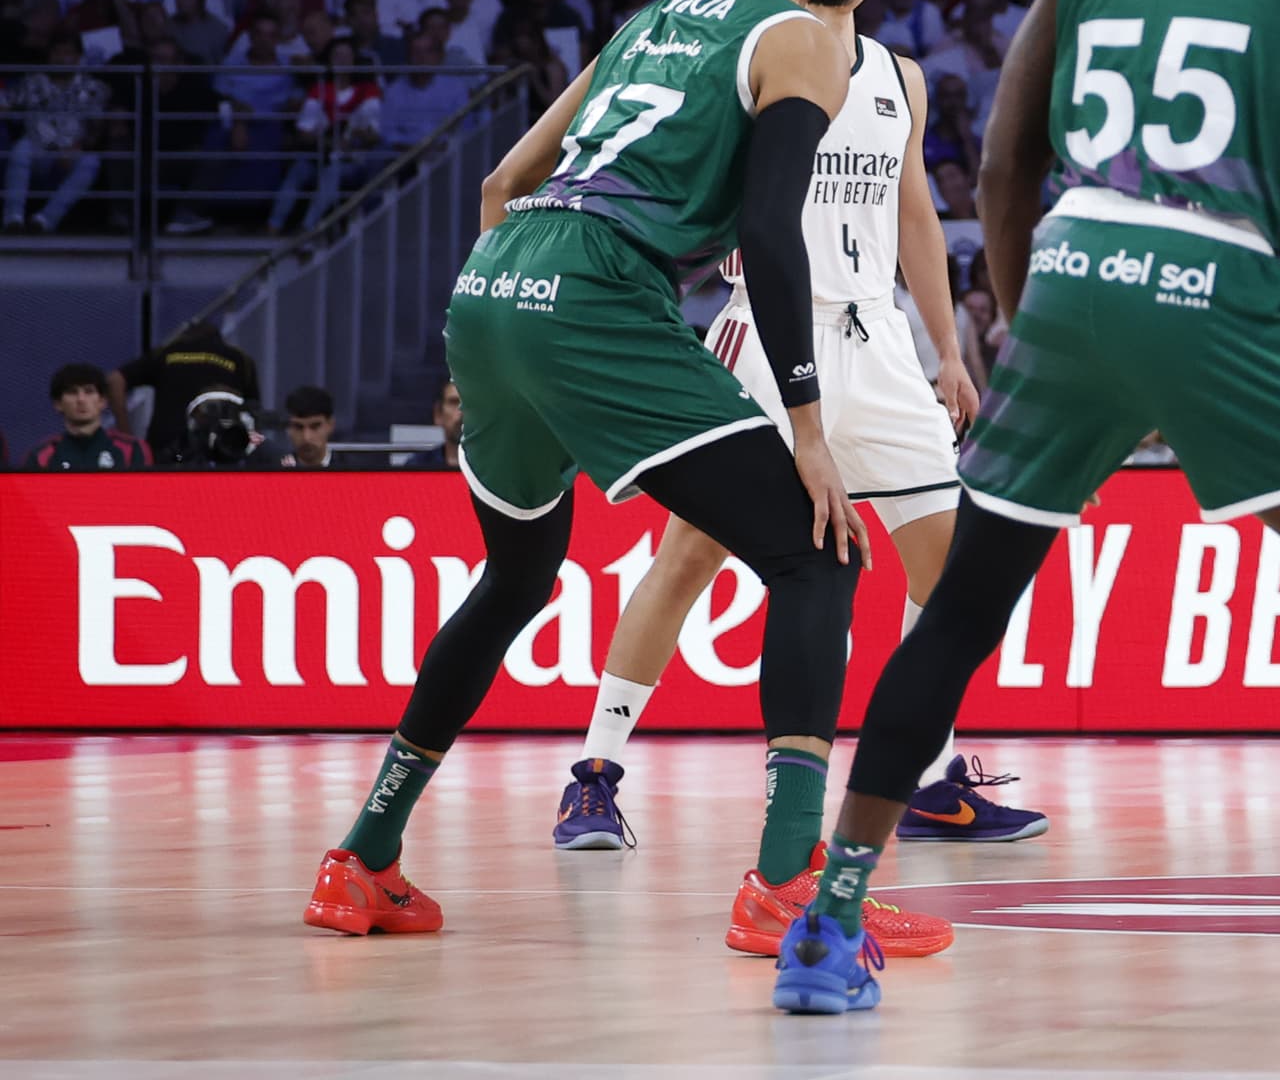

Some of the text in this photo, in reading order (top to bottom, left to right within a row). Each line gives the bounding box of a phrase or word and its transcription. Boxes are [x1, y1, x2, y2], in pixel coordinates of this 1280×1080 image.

[1065, 16, 1251, 170] 55
[551, 82, 686, 181] 17
[815, 146, 899, 180] mirate
[814, 181, 839, 204] FLY
[842, 223, 860, 273] 4
[1098, 249, 1154, 286] del
[1158, 262, 1217, 297] sol
[490, 271, 521, 299] del
[519, 274, 561, 302] sol
[997, 523, 1132, 688] LY
[367, 762, 411, 814] UNICAJA
